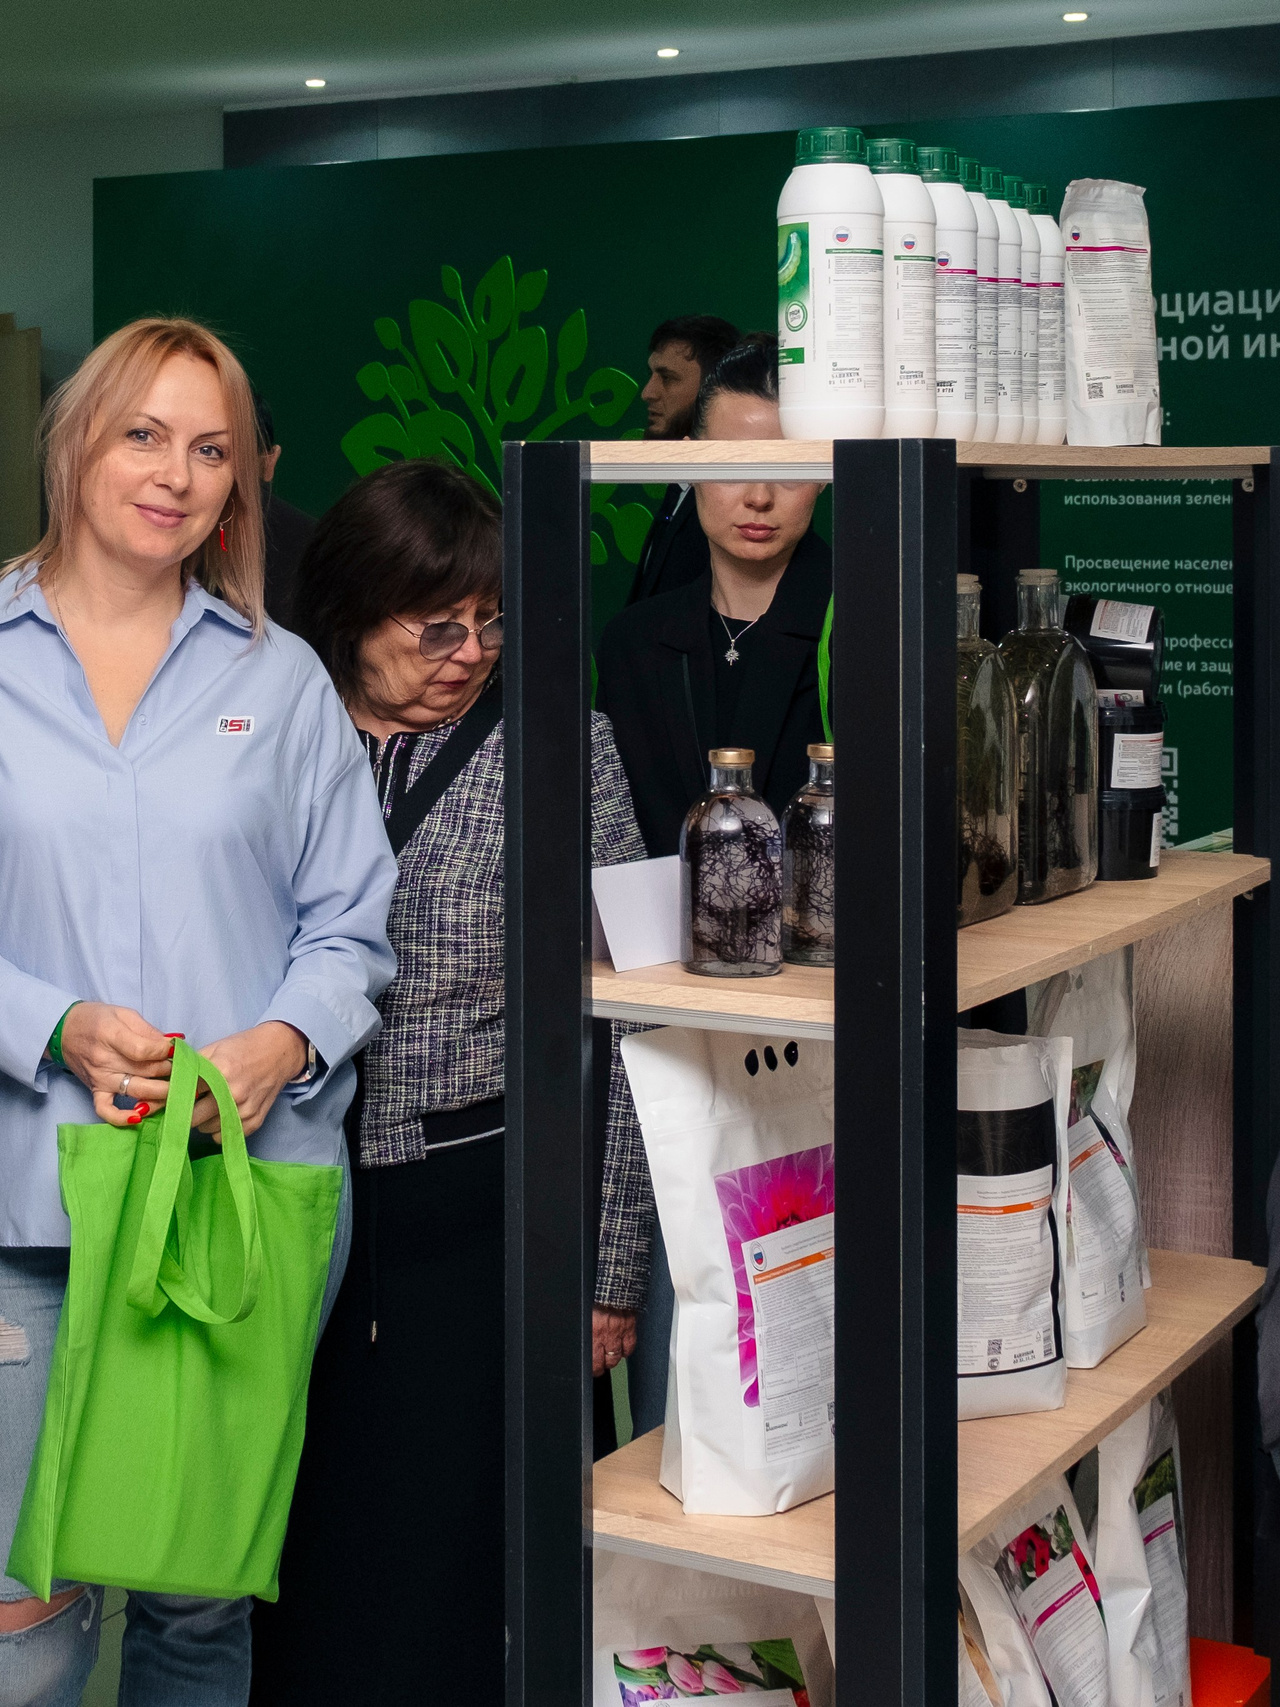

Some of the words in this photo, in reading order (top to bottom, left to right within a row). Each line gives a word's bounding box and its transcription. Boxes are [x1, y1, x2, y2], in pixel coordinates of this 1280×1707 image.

[1152, 288, 1280, 324] циаци
[1064, 493, 1181, 506] использования
[1185, 493, 1233, 506] зелен
[1064, 554, 1170, 573] Просвещение
[1064, 580, 1171, 593] экологичного
[1161, 660, 1183, 672] ие
[1186, 661, 1196, 672] и
[1200, 661, 1234, 675] защ
